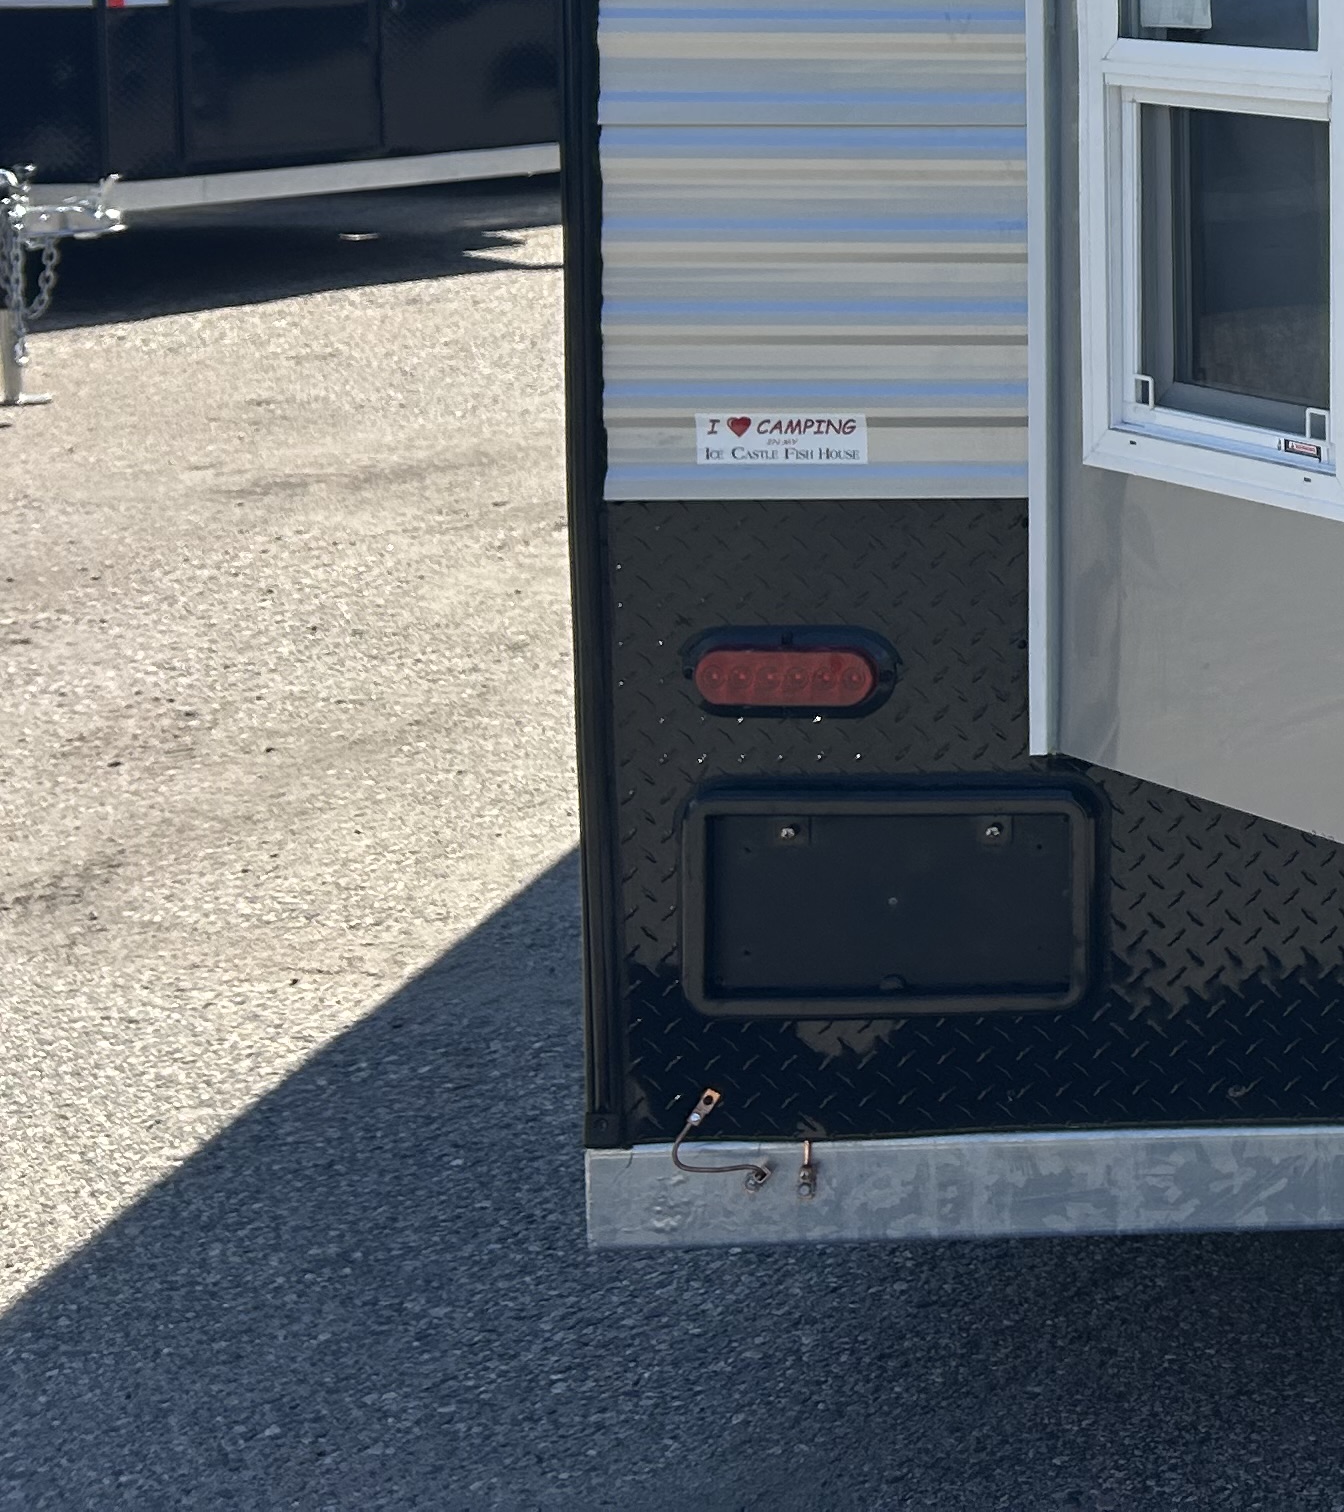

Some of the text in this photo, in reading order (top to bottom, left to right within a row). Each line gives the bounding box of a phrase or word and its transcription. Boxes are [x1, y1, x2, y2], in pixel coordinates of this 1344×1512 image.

[706, 419, 857, 435] I CAMPING
[731, 447, 779, 460] CASTLE
[819, 447, 860, 460] HOUSE
